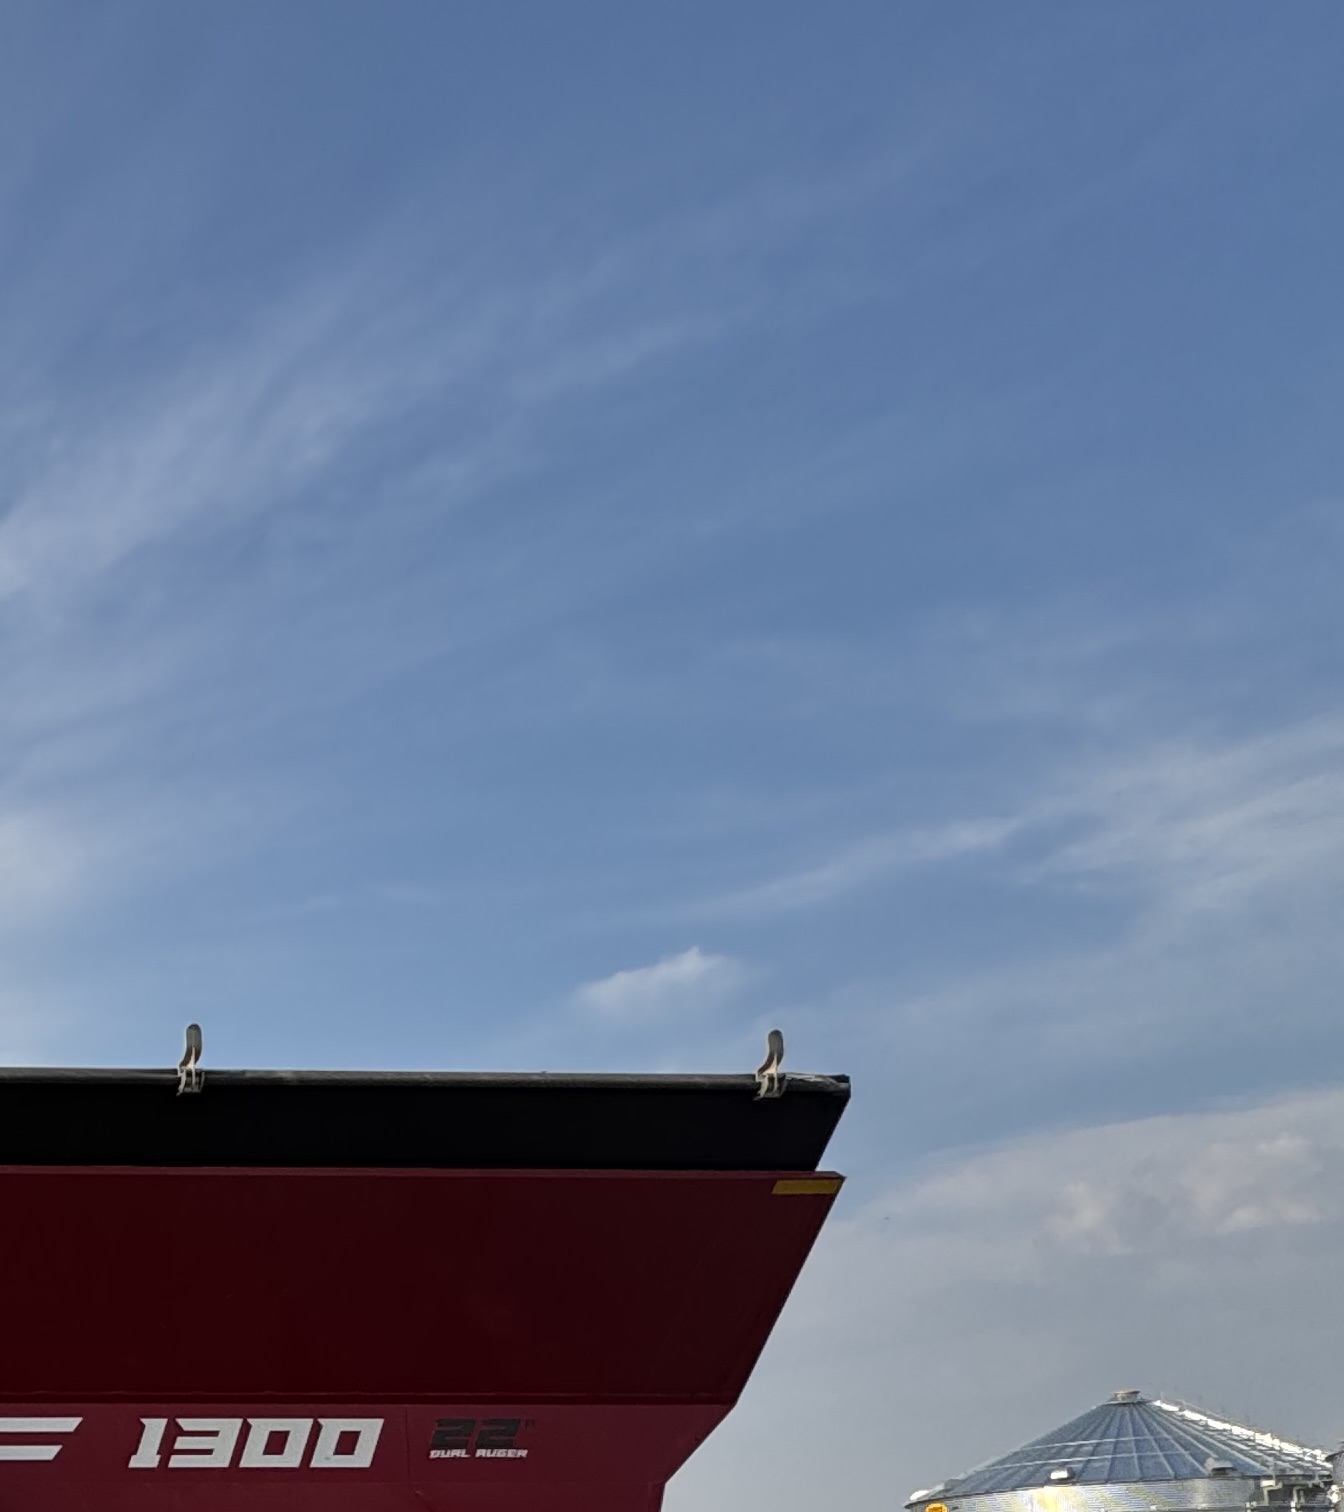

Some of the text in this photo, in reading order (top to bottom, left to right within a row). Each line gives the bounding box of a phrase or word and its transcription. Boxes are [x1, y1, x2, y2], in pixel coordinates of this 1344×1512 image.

[127, 1417, 385, 1468] 1300
[429, 1448, 528, 1459] DUAL AUGER
